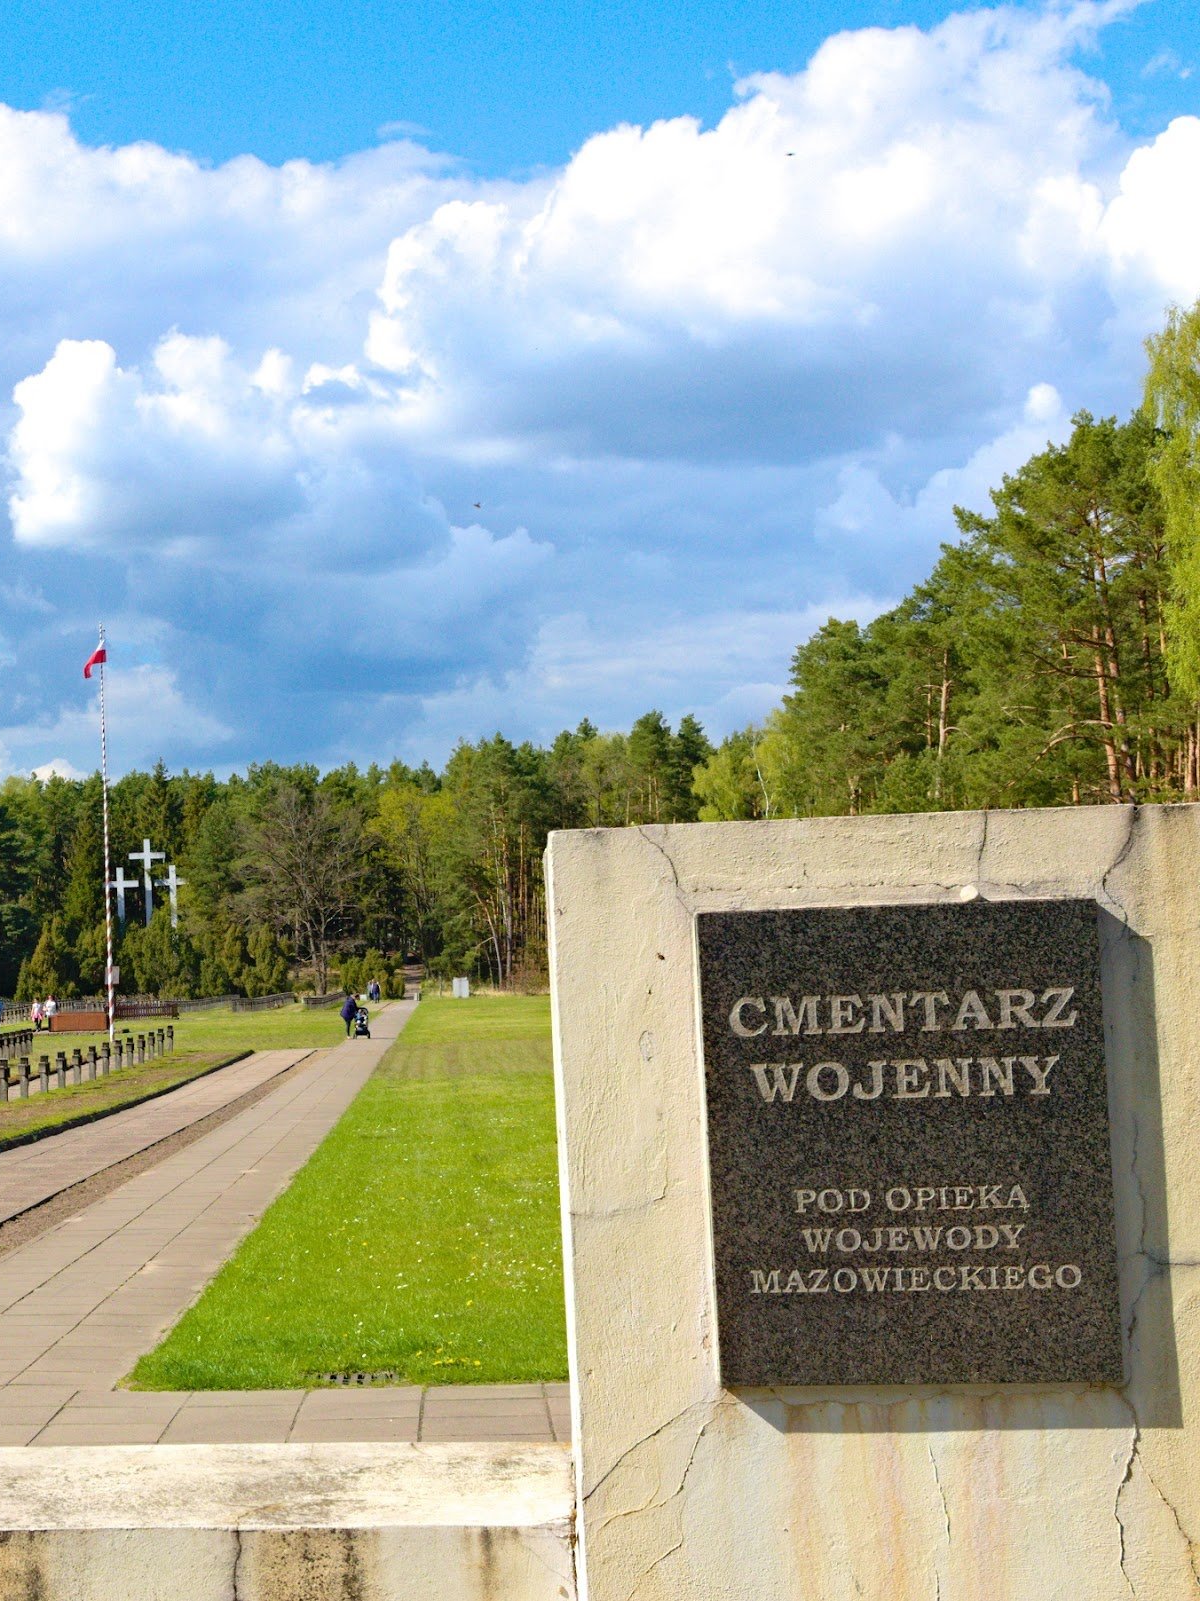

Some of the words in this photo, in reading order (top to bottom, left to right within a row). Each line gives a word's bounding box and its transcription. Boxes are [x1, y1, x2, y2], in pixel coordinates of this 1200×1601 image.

[728, 985, 1081, 1038] CMENTARZ
[749, 1054, 1061, 1103] WOJENNY
[793, 1187, 871, 1214] POD
[801, 1223, 1026, 1253] WOJEWODY
[749, 1264, 1083, 1295] MAZOWIECKIEGO
